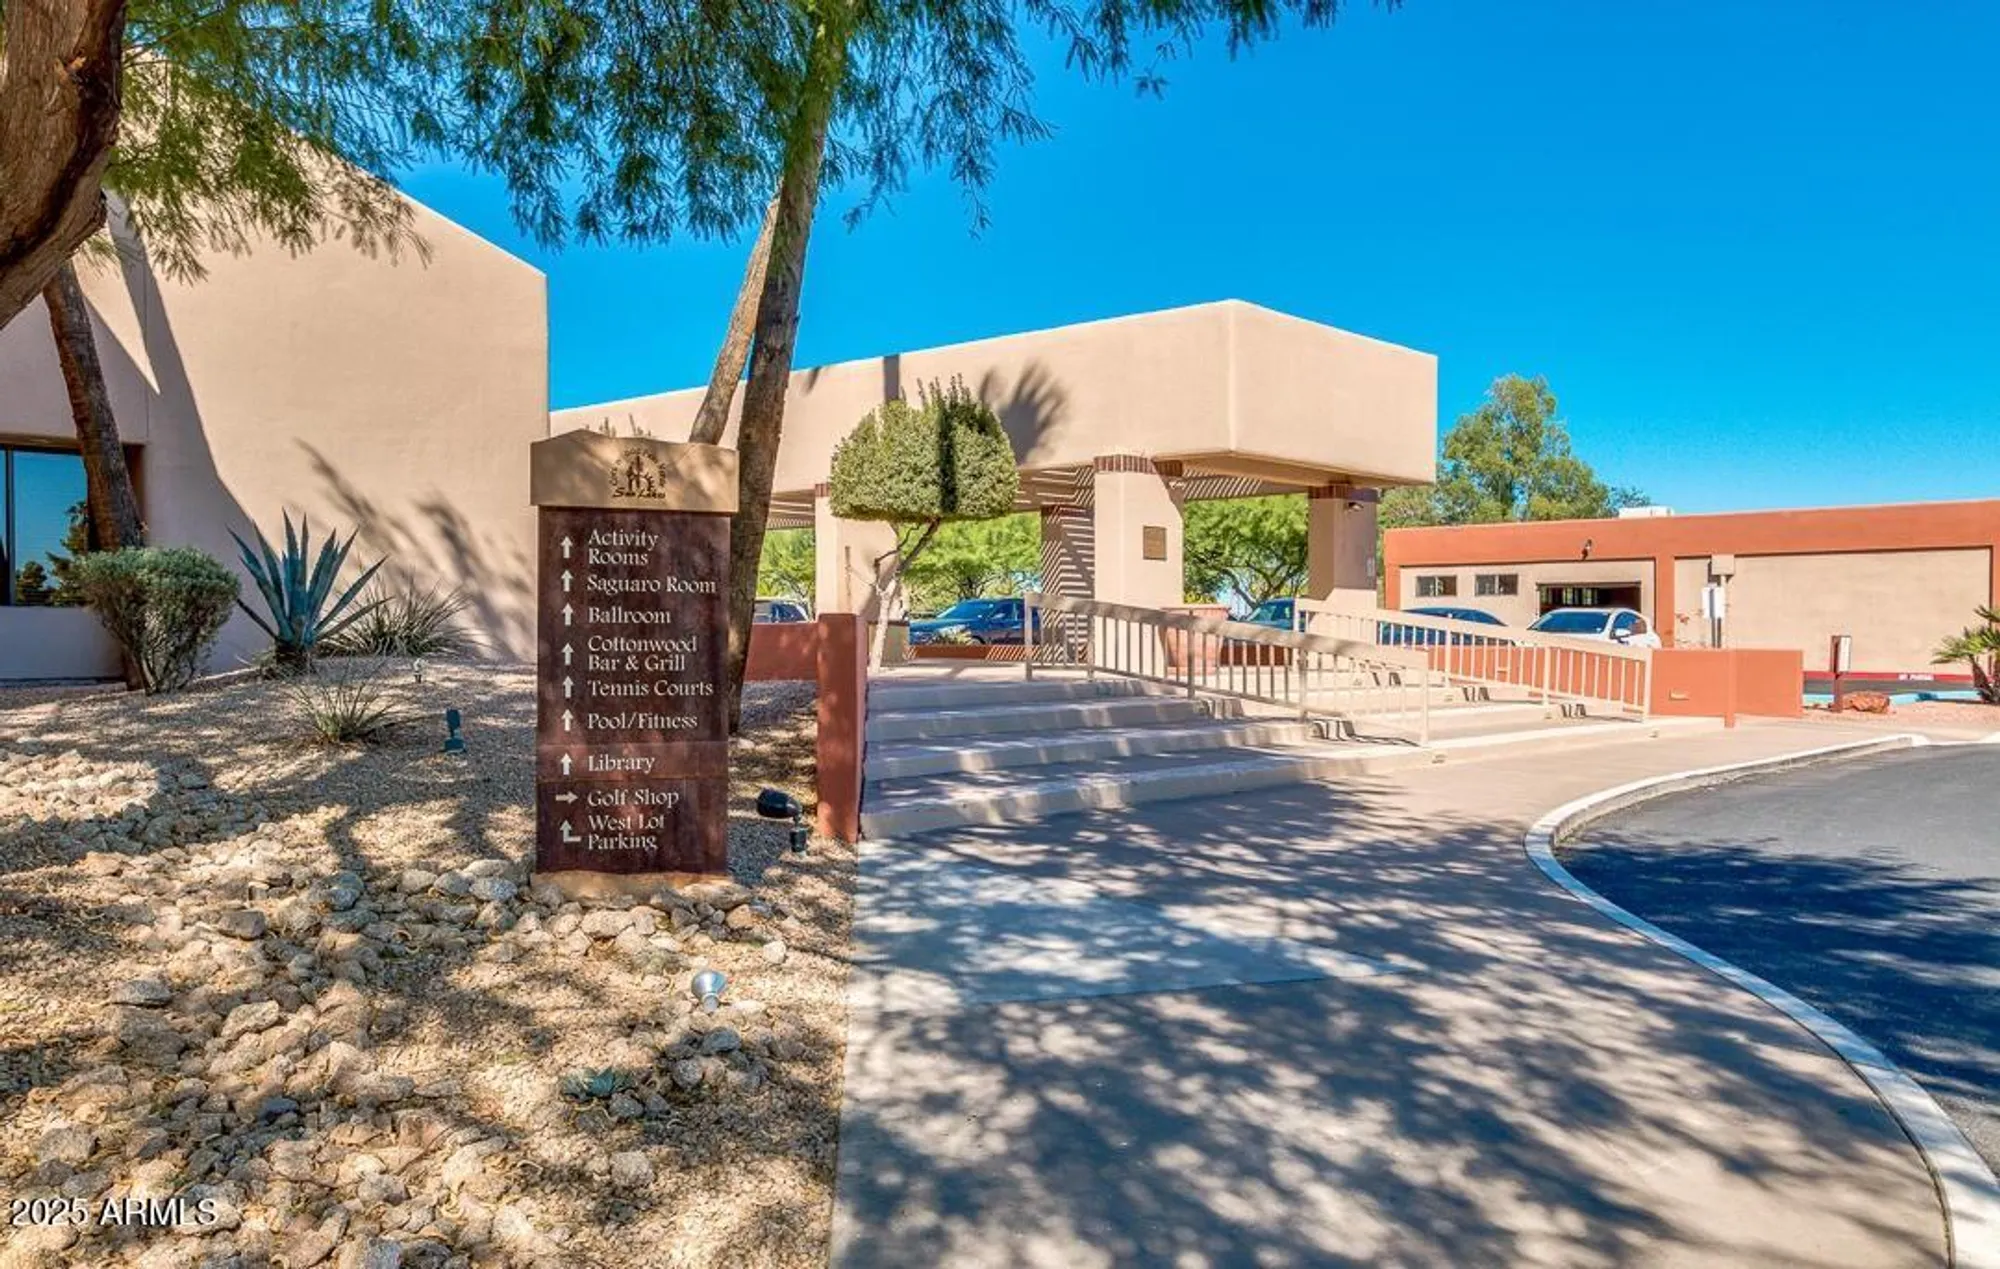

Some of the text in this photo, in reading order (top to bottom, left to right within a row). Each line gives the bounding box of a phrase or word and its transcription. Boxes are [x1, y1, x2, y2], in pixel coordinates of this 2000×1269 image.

[588, 529, 659, 551] Activity
[588, 549, 648, 565] Rooms
[587, 574, 717, 595] Saguaro Room
[588, 606, 671, 624] Ballroom
[588, 635, 697, 652] Cottonwood
[588, 654, 685, 672] Bar & Grill
[587, 679, 714, 697] Tennis Courts
[588, 712, 698, 730] Pool/Fitness
[588, 755, 655, 774] Library
[587, 788, 679, 809] Golf Shop
[588, 814, 665, 830] West Lot
[588, 832, 658, 851] Parking
